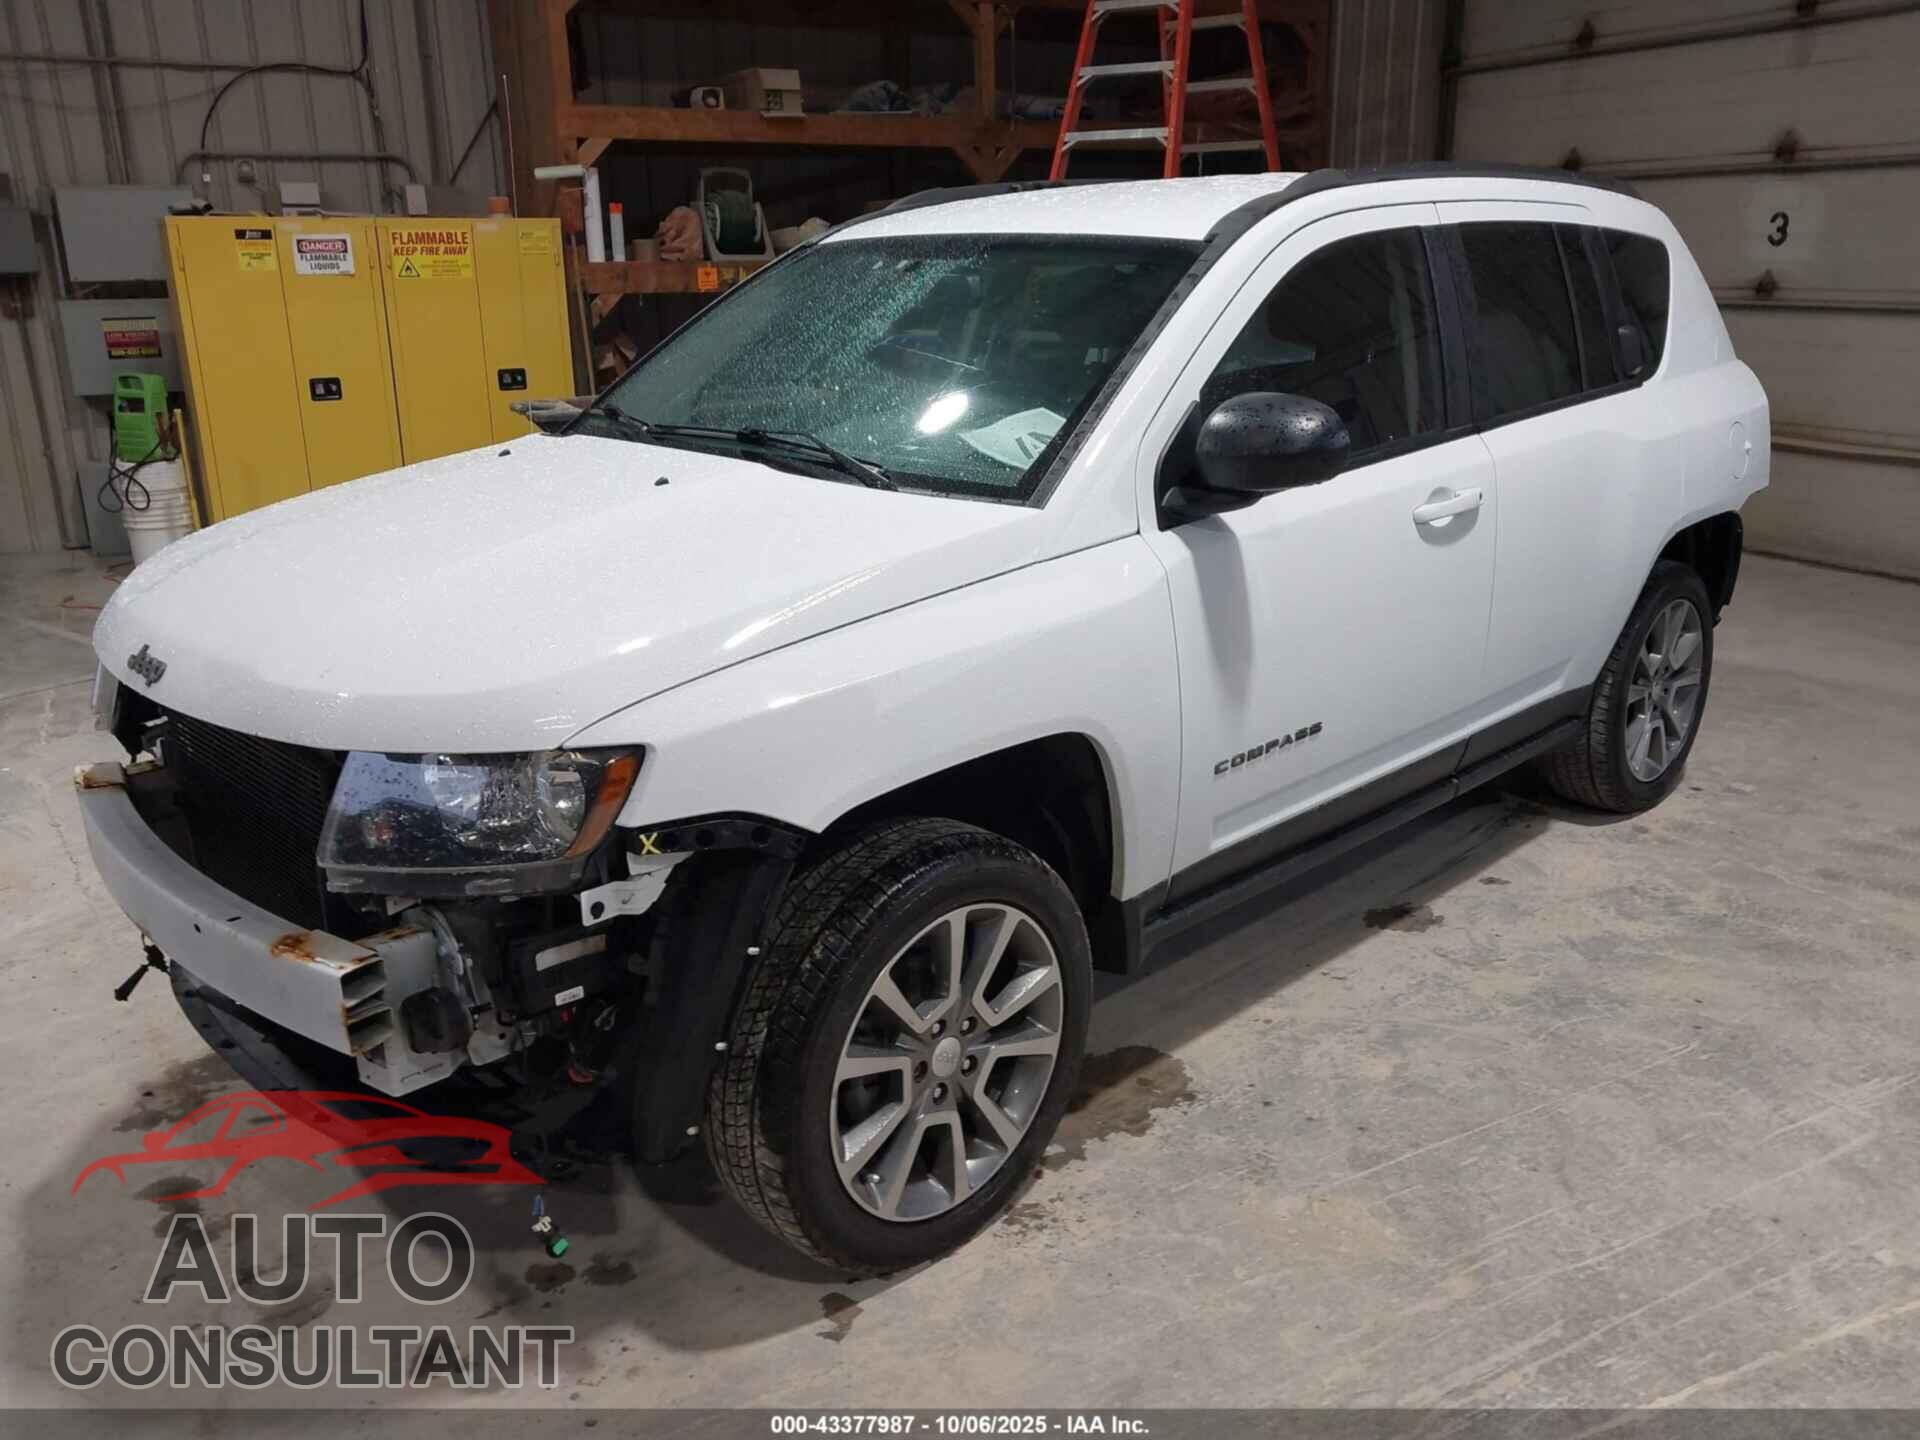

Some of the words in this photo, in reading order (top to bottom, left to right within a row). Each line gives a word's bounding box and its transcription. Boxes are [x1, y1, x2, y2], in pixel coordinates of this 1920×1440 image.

[1767, 211, 1790, 247] 3
[391, 231, 469, 245] FLAMMABLE
[301, 241, 344, 251] DANGER
[393, 246, 418, 256] KEEP
[420, 246, 441, 256] FIRE
[442, 246, 469, 256] AWAY
[300, 253, 347, 262] FLAMMABLE
[310, 262, 341, 271] LIQUIDS
[1213, 721, 1323, 775] COMPASS
[640, 832, 661, 855] X
